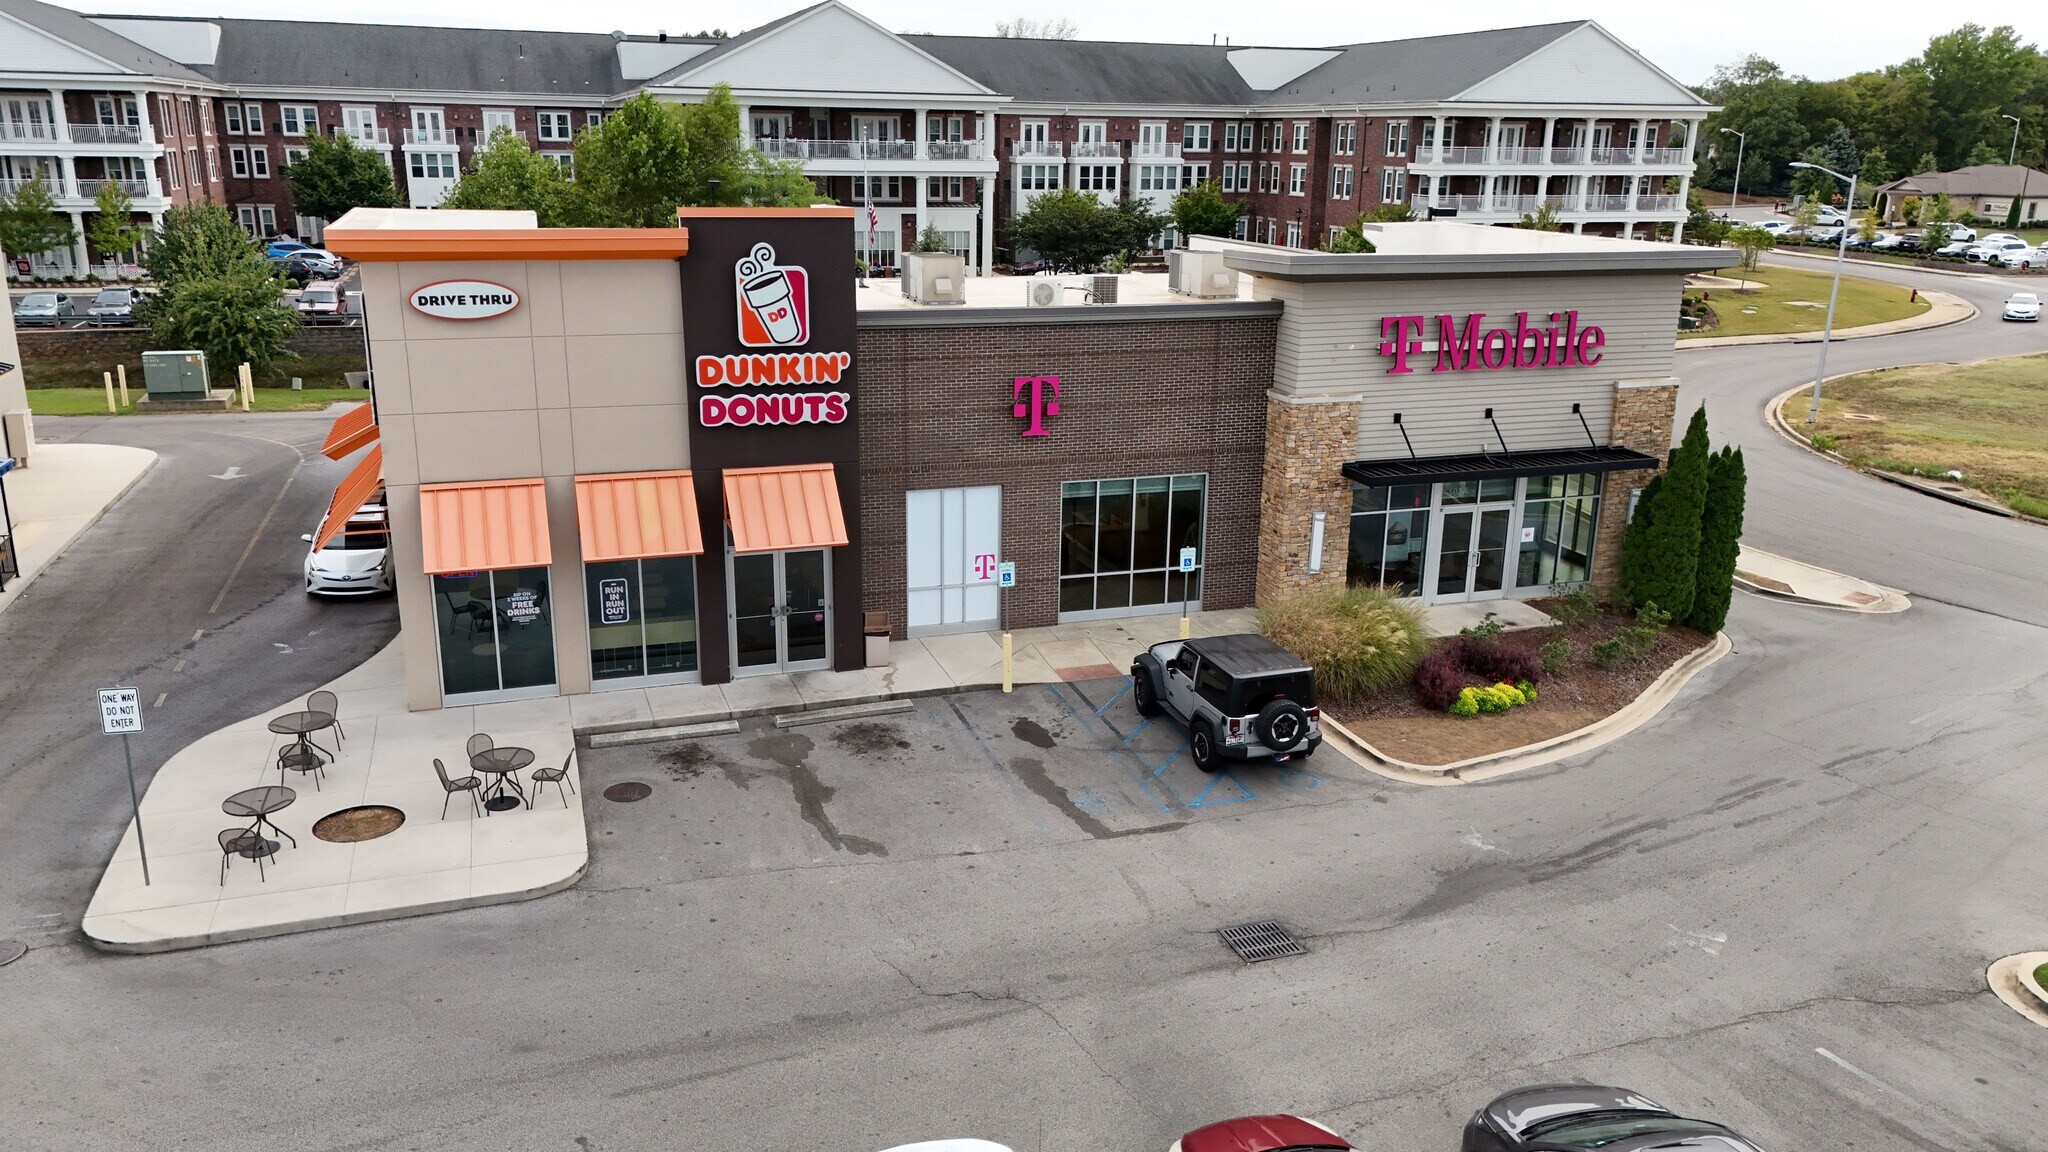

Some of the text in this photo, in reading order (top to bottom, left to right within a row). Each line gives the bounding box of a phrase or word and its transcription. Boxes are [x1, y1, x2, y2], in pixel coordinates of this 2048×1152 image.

[418, 294, 512, 306] DRIVE THRU
[767, 307, 787, 323] DD
[1380, 310, 1605, 374] T Mobile
[698, 354, 849, 385] DUNKIN'
[702, 394, 845, 425] DONUTS
[1013, 376, 1060, 436] T
[974, 554, 995, 580] T
[605, 586, 624, 594] RUN
[610, 593, 620, 601] IN
[512, 601, 534, 609] FREE
[606, 600, 625, 608] RUN
[507, 607, 540, 616] DRINKS
[606, 607, 625, 615] OUT
[101, 693, 135, 704] ONE WAY
[106, 705, 134, 716] DO NOT
[111, 718, 134, 729] ENTER
